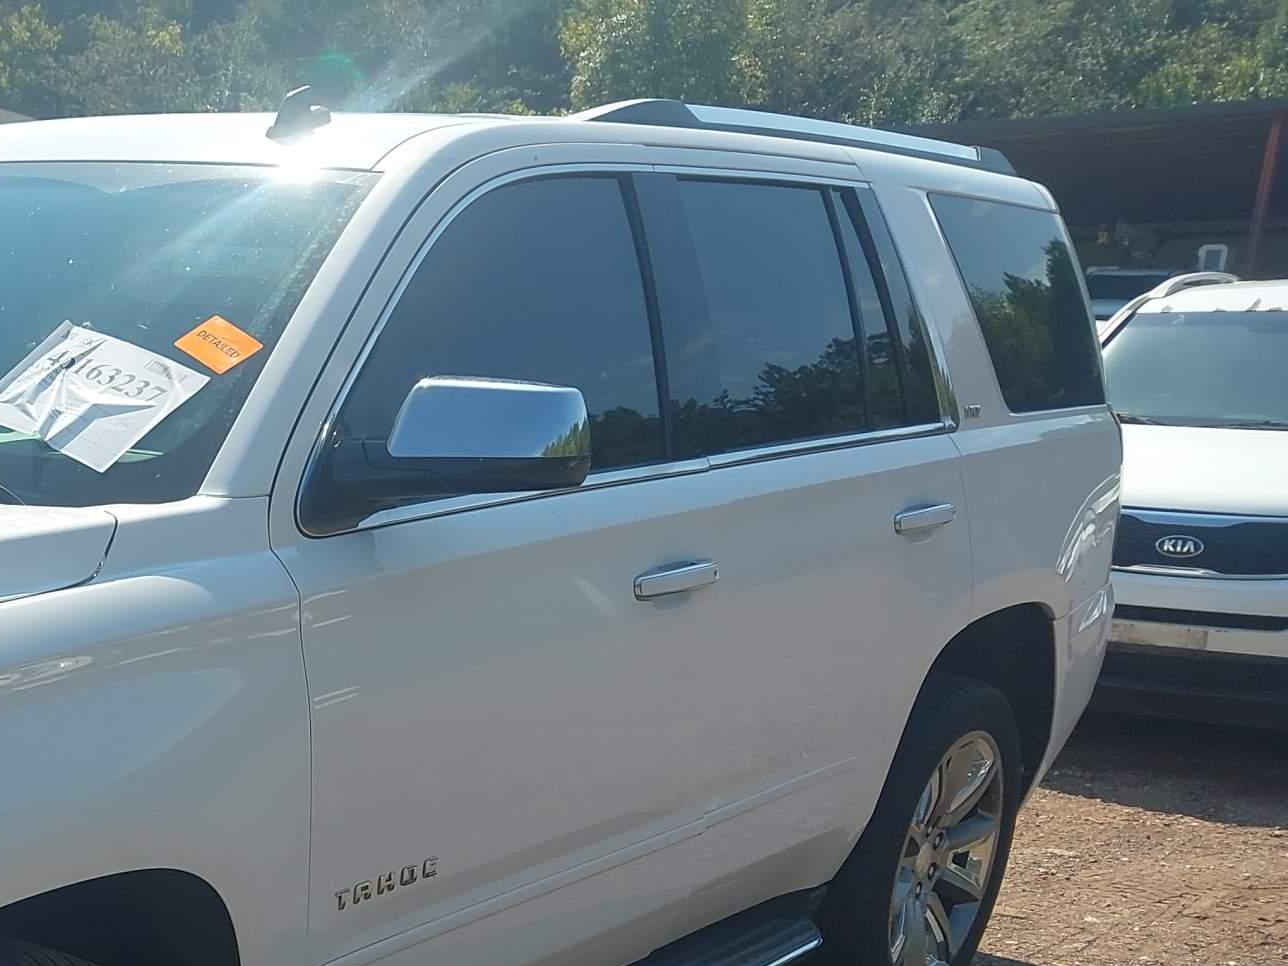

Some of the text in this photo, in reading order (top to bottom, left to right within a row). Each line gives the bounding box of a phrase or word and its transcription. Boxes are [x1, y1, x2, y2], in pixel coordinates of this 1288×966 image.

[196, 329, 240, 359] DETAILED
[1163, 539, 1196, 553] KIA
[334, 856, 439, 911] TAHOE
